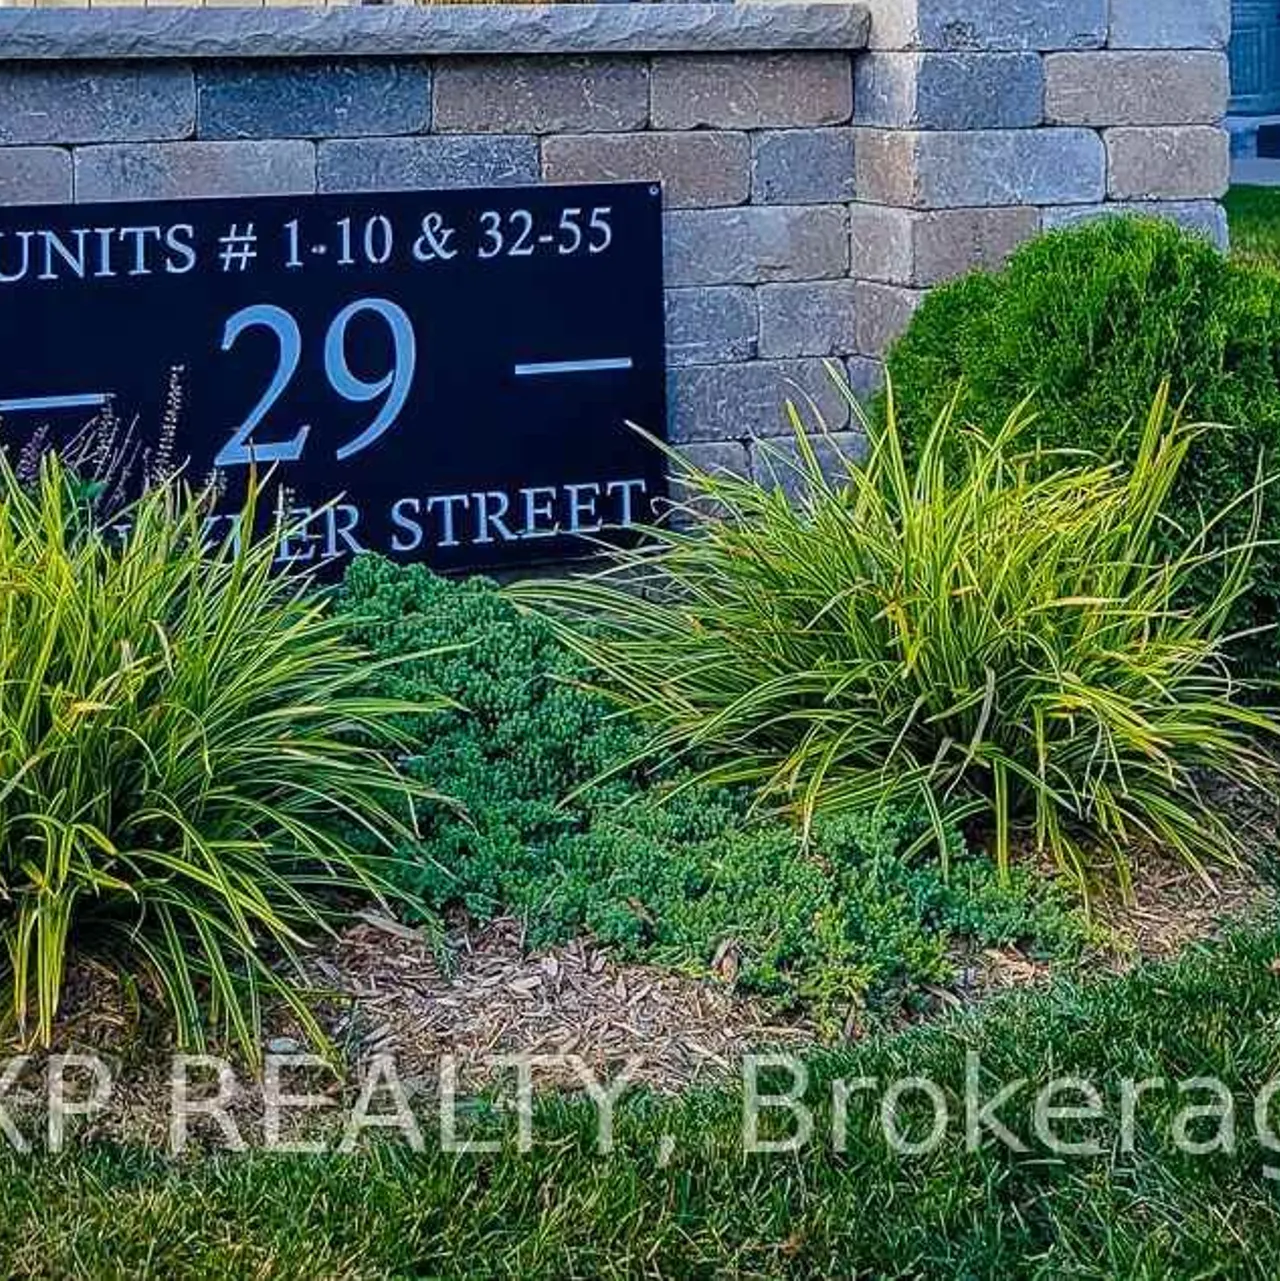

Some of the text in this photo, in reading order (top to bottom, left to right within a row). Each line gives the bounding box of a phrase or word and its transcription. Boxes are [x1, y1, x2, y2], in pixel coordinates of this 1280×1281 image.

[218, 222, 257, 272] #
[284, 216, 394, 267] 1-10
[413, 211, 459, 261] &
[478, 206, 613, 258] 32-55
[216, 297, 417, 466] 29
[391, 479, 647, 552] STREET
